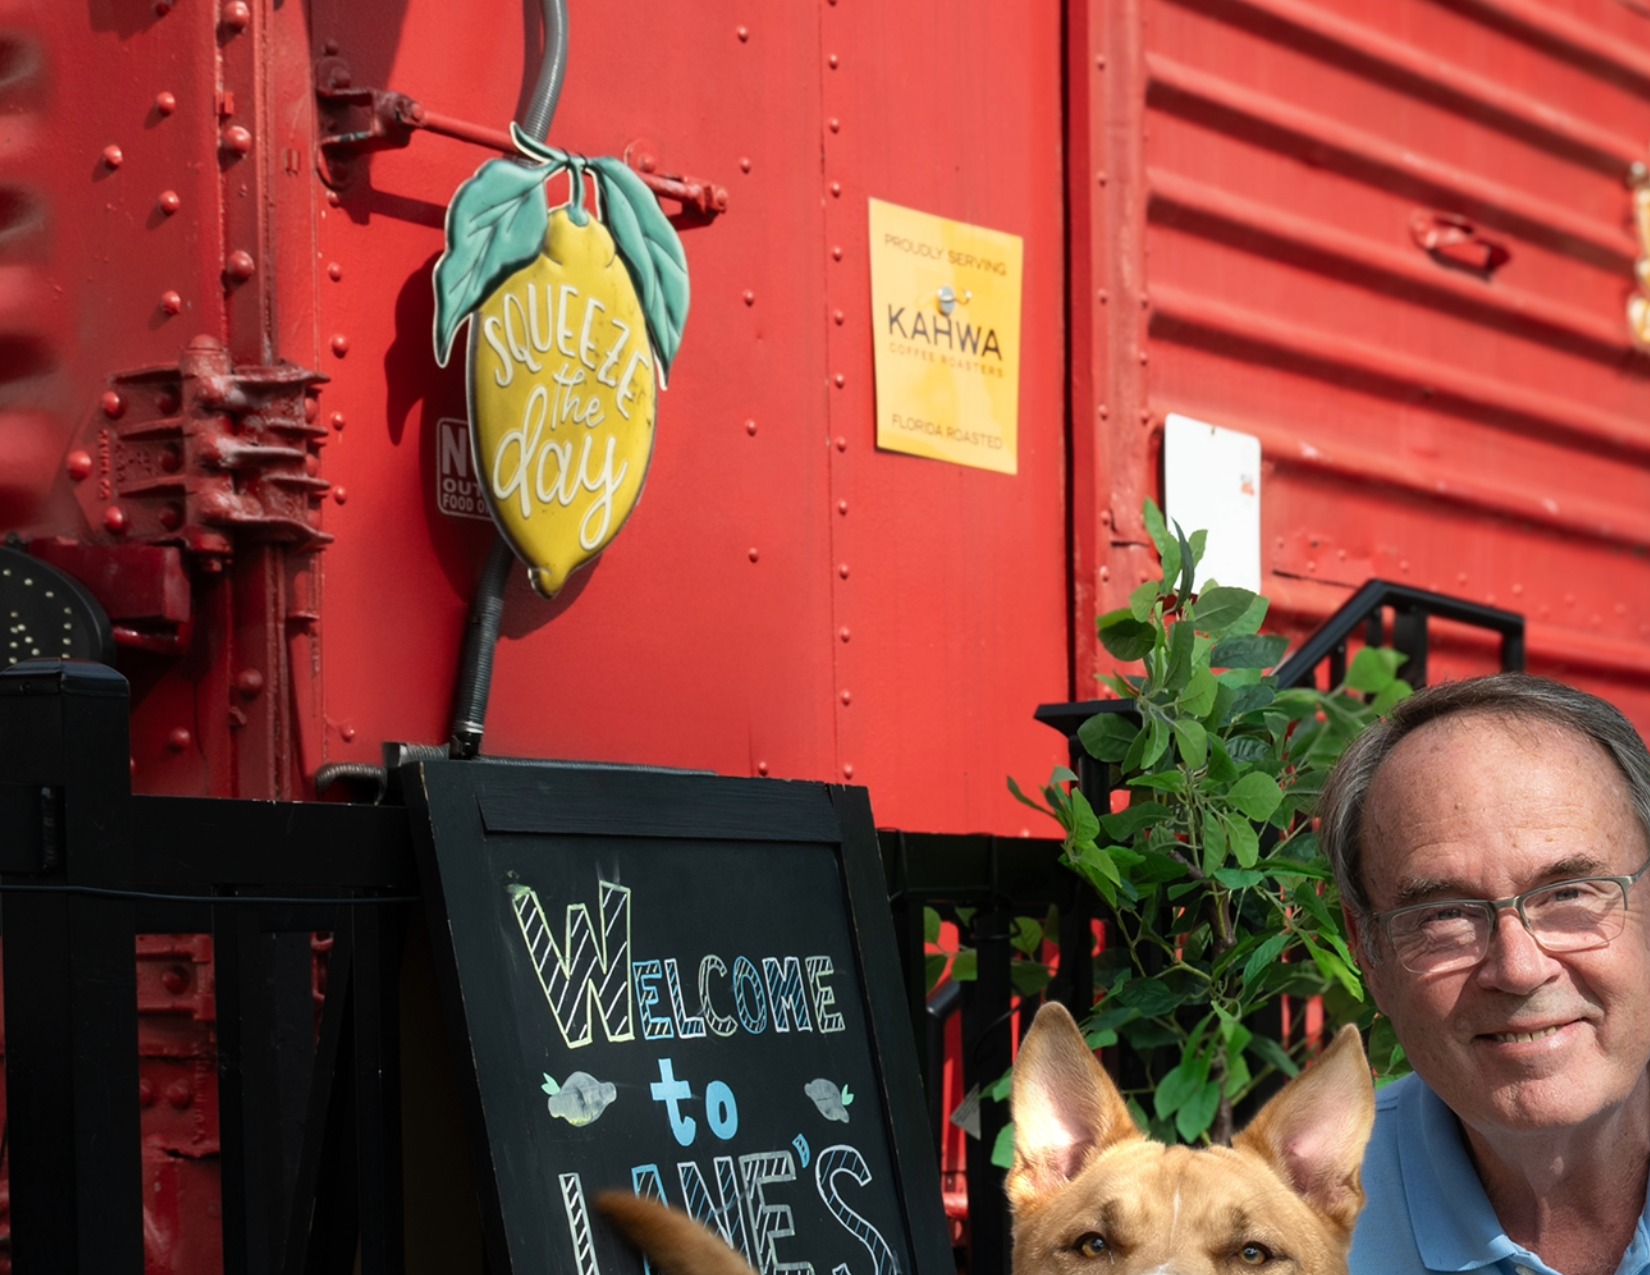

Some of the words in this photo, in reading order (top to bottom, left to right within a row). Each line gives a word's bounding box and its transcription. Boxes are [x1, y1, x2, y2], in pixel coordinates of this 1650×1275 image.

[885, 233, 944, 261] PROUDLY
[947, 250, 1007, 277] SERVING
[484, 282, 649, 420] SQUEEZE
[887, 303, 1003, 361] KAHWA
[889, 342, 935, 363] COFFEE
[940, 354, 1004, 379] ROASTERS
[553, 362, 605, 431] the
[442, 424, 467, 478] N
[892, 414, 943, 439] FLORIDA
[946, 427, 1003, 450] ROASTED
[492, 385, 628, 551] day
[442, 493, 474, 512] FOOD
[512, 880, 846, 1050] WELCOME
[650, 1058, 738, 1147] to
